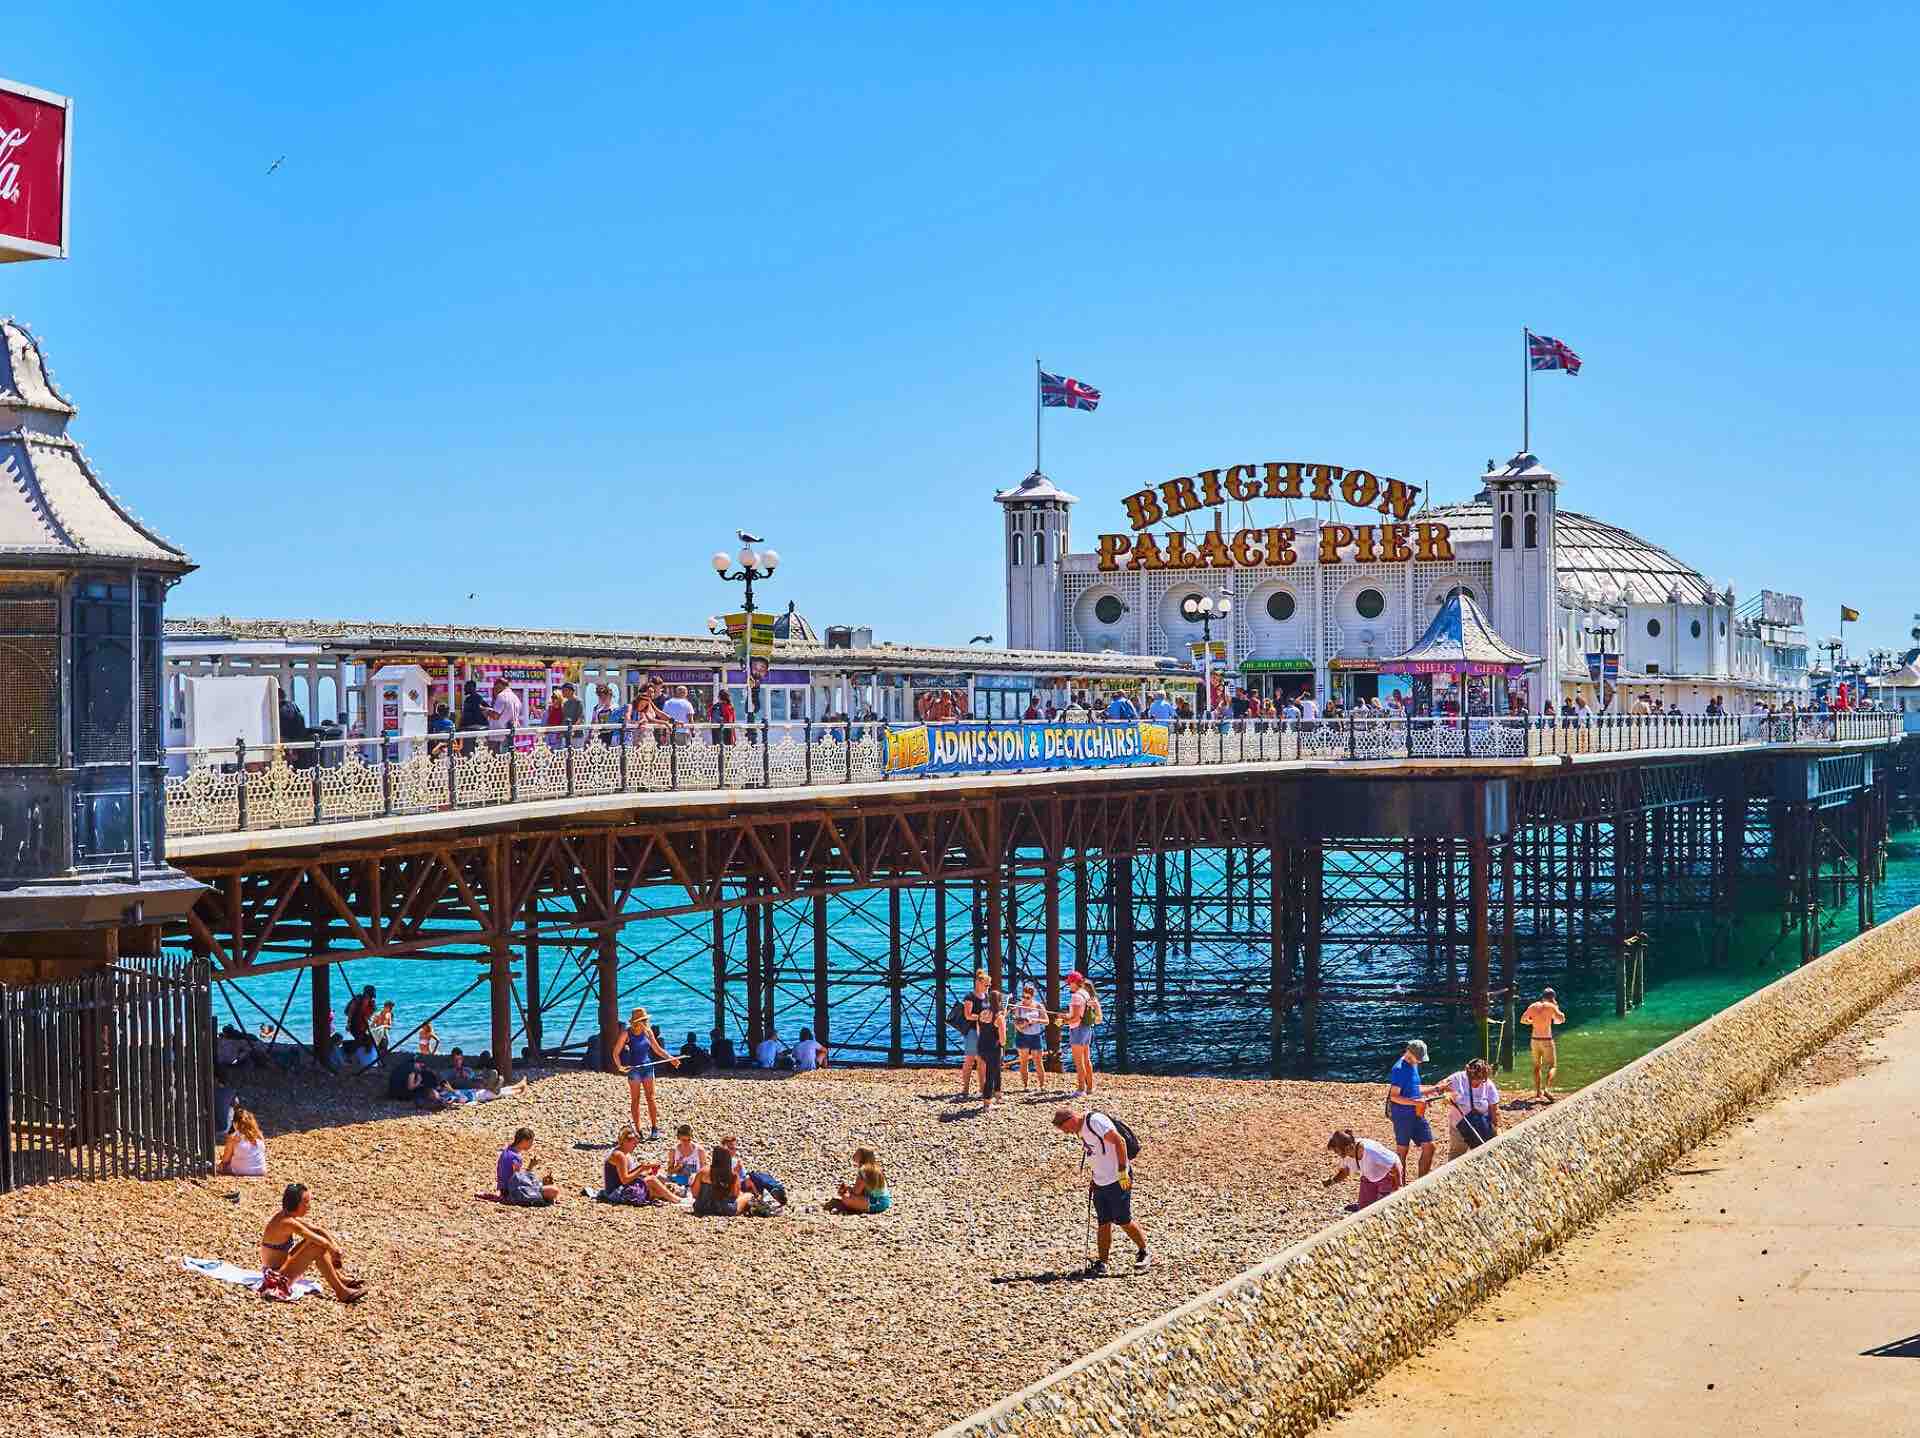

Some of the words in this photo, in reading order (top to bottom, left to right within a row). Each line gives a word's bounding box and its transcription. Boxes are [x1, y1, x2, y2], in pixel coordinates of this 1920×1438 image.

[1121, 462, 1422, 531] BRIGHTON
[1097, 526, 1297, 571] PALACE
[1318, 522, 1455, 564] PIER
[1415, 663, 1456, 673] SHELLS
[1474, 663, 1505, 673] GIFTS
[933, 729, 1024, 765] ADMISSION
[1029, 732, 1037, 760] &
[1044, 727, 1139, 761] DECKCHAIRS!
